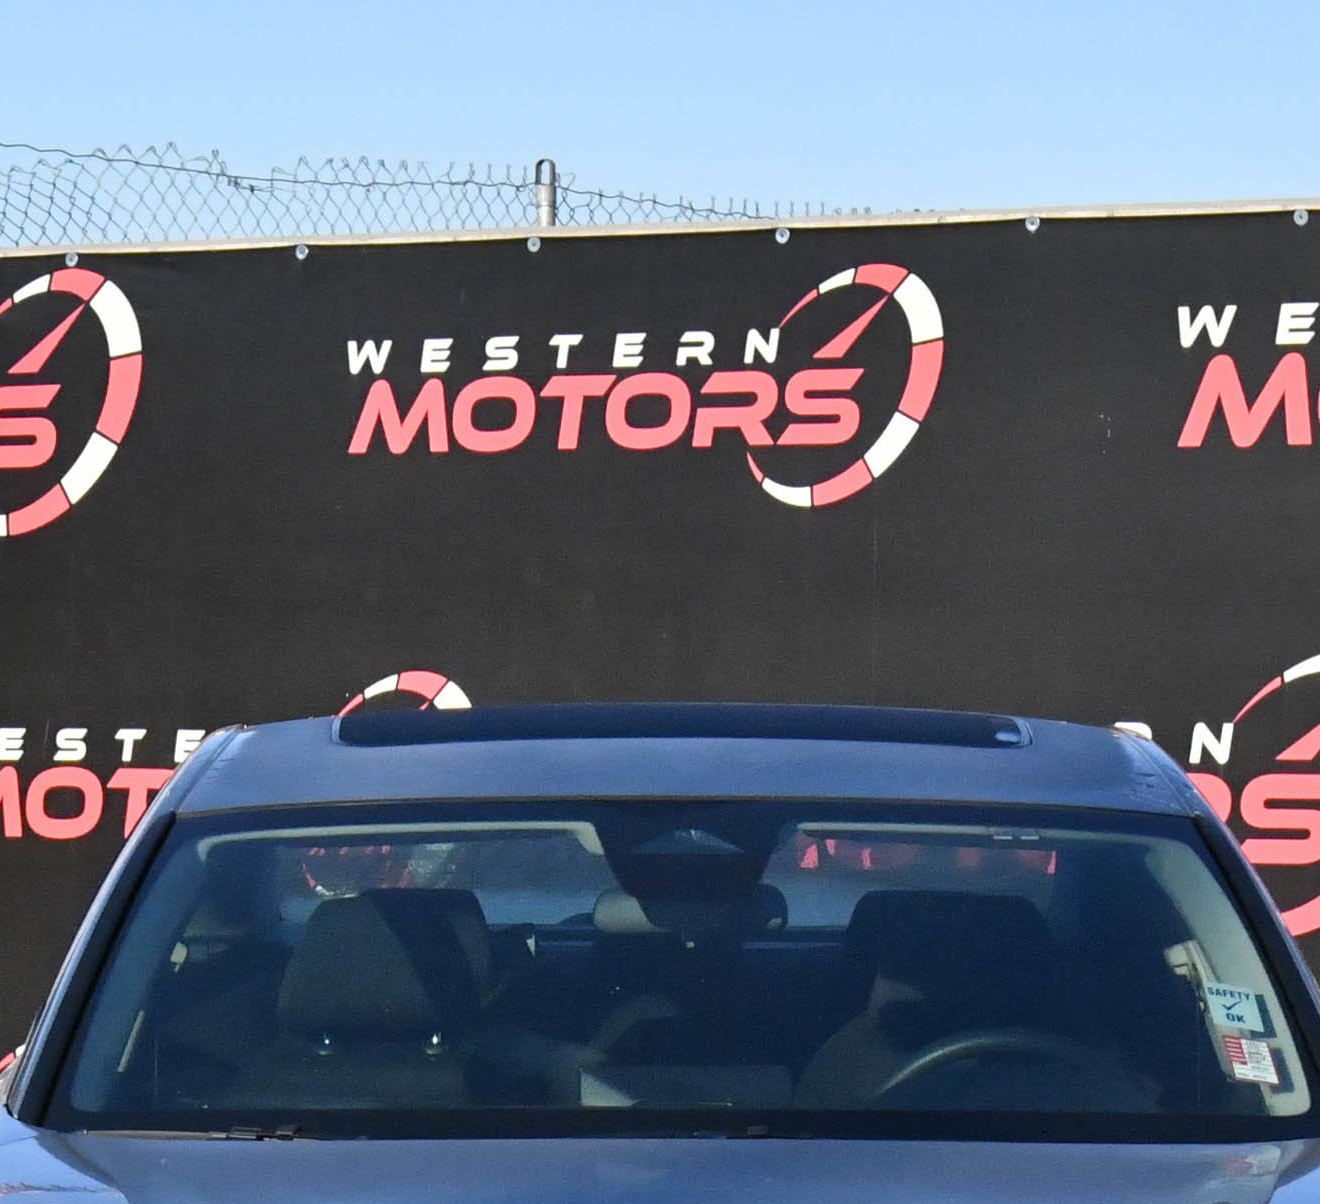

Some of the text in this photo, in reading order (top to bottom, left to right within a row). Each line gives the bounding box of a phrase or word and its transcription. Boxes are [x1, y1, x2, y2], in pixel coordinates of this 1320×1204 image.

[347, 327, 780, 375] WESTERN
[347, 368, 865, 455] MOTORS
[1207, 986, 1250, 1000] SAFETY
[1225, 1012, 1246, 1024] OK
